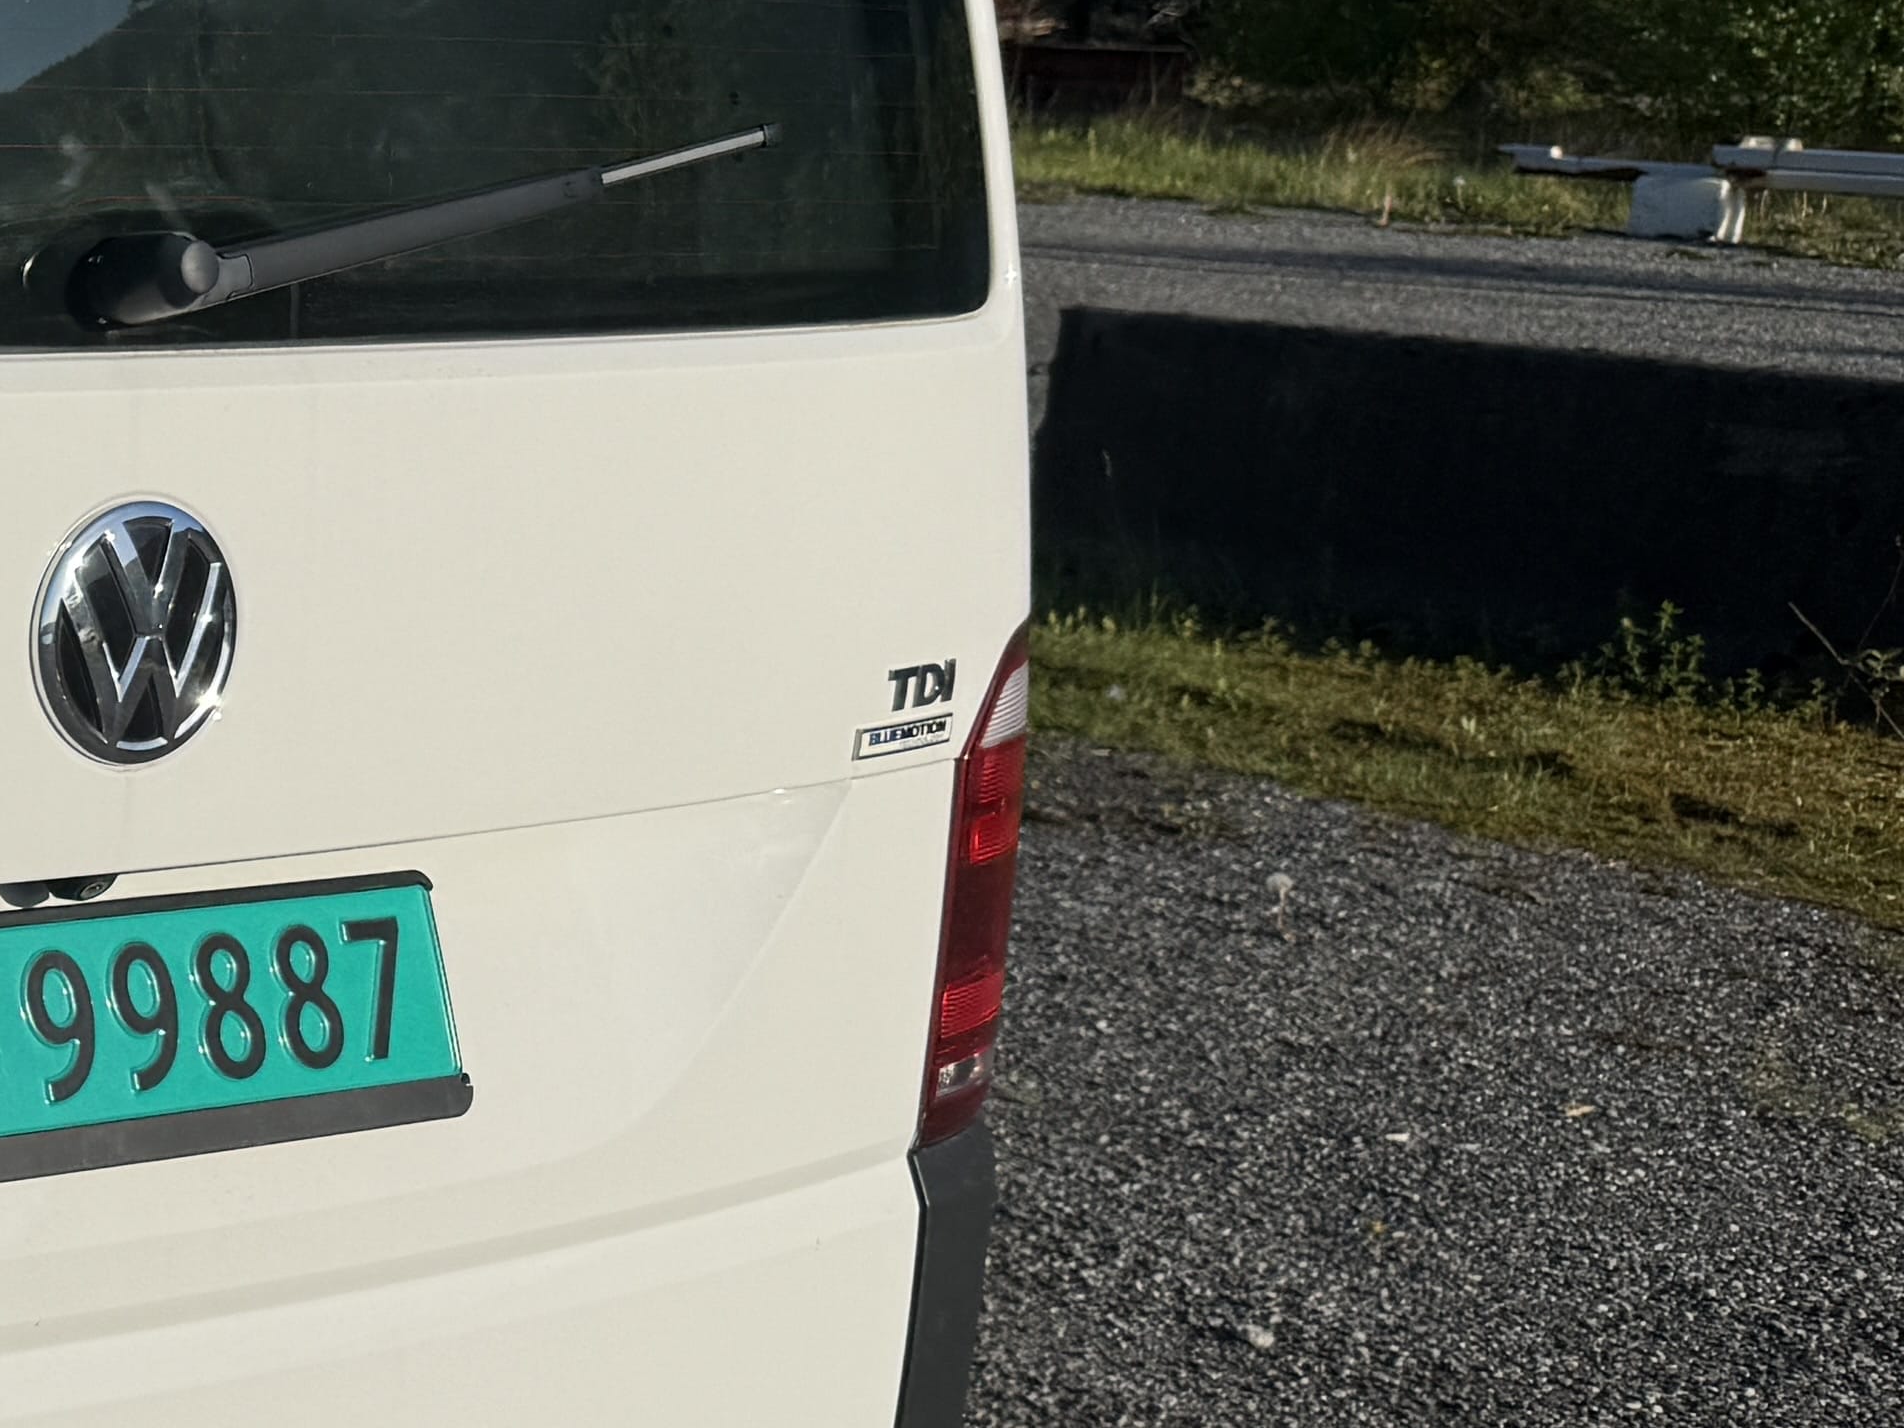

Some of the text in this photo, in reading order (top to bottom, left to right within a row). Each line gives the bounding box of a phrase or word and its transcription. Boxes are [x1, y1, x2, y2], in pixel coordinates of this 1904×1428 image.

[888, 658, 956, 712] TDI
[868, 719, 947, 746] BLUEMOTION
[20, 914, 400, 1106] 99887
